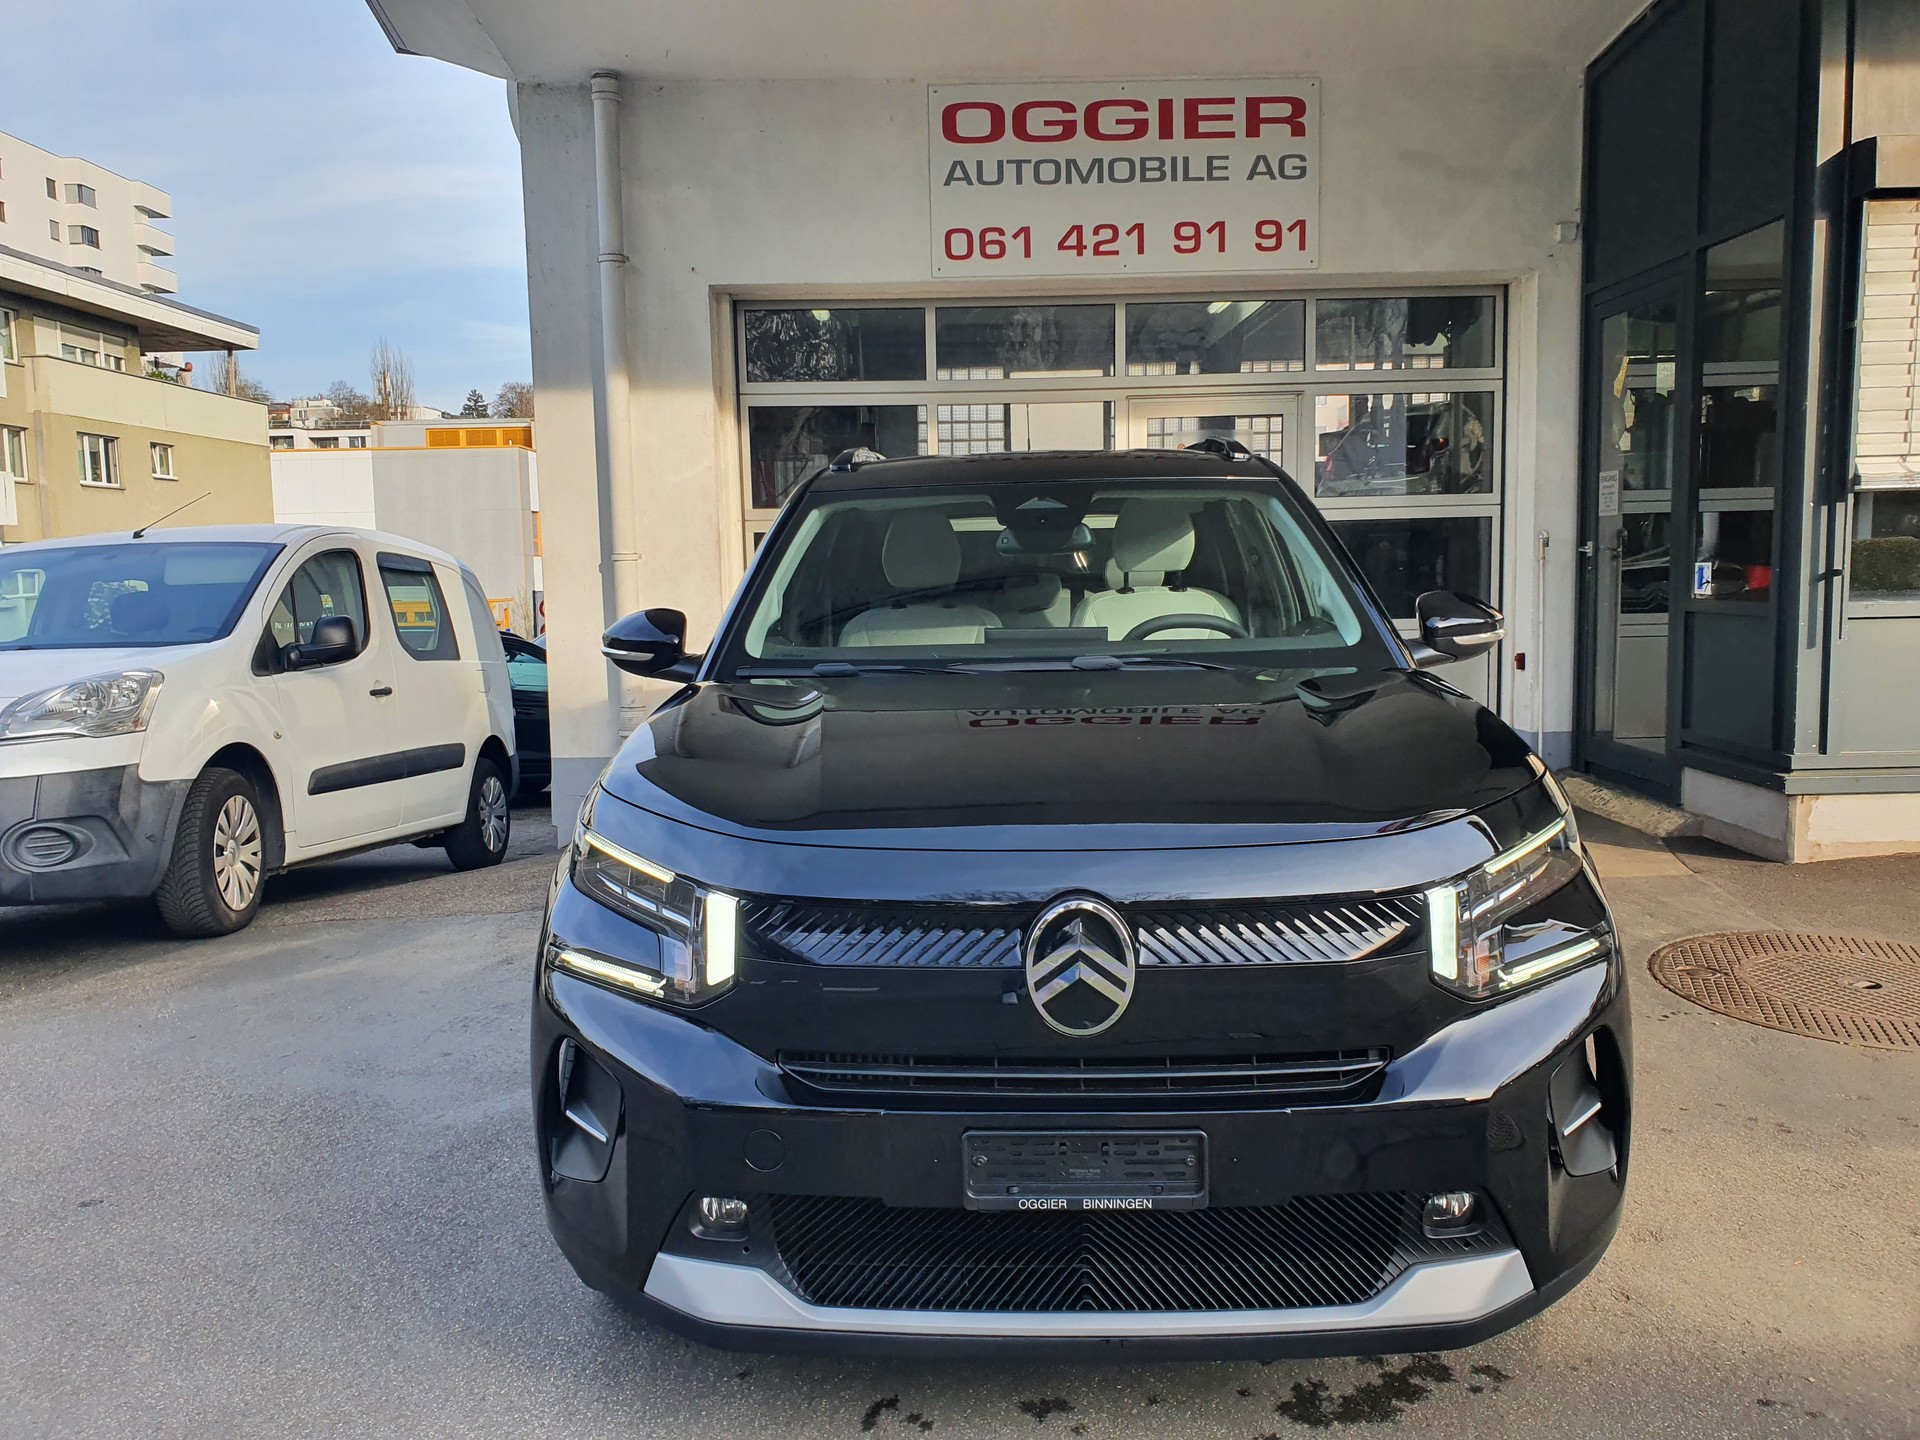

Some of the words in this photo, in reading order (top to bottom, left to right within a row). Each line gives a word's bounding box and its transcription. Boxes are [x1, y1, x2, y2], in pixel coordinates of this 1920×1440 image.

[941, 96, 1306, 144] OGGIER
[943, 155, 1230, 186] AUTOMOBILE
[1246, 154, 1308, 181] AG
[944, 226, 1032, 261] 061
[1057, 223, 1145, 257] 421
[1173, 221, 1226, 254] 91
[1254, 219, 1307, 252] 91
[1018, 1198, 1067, 1209] OGGIER
[1082, 1198, 1152, 1209] BINNINGEN
